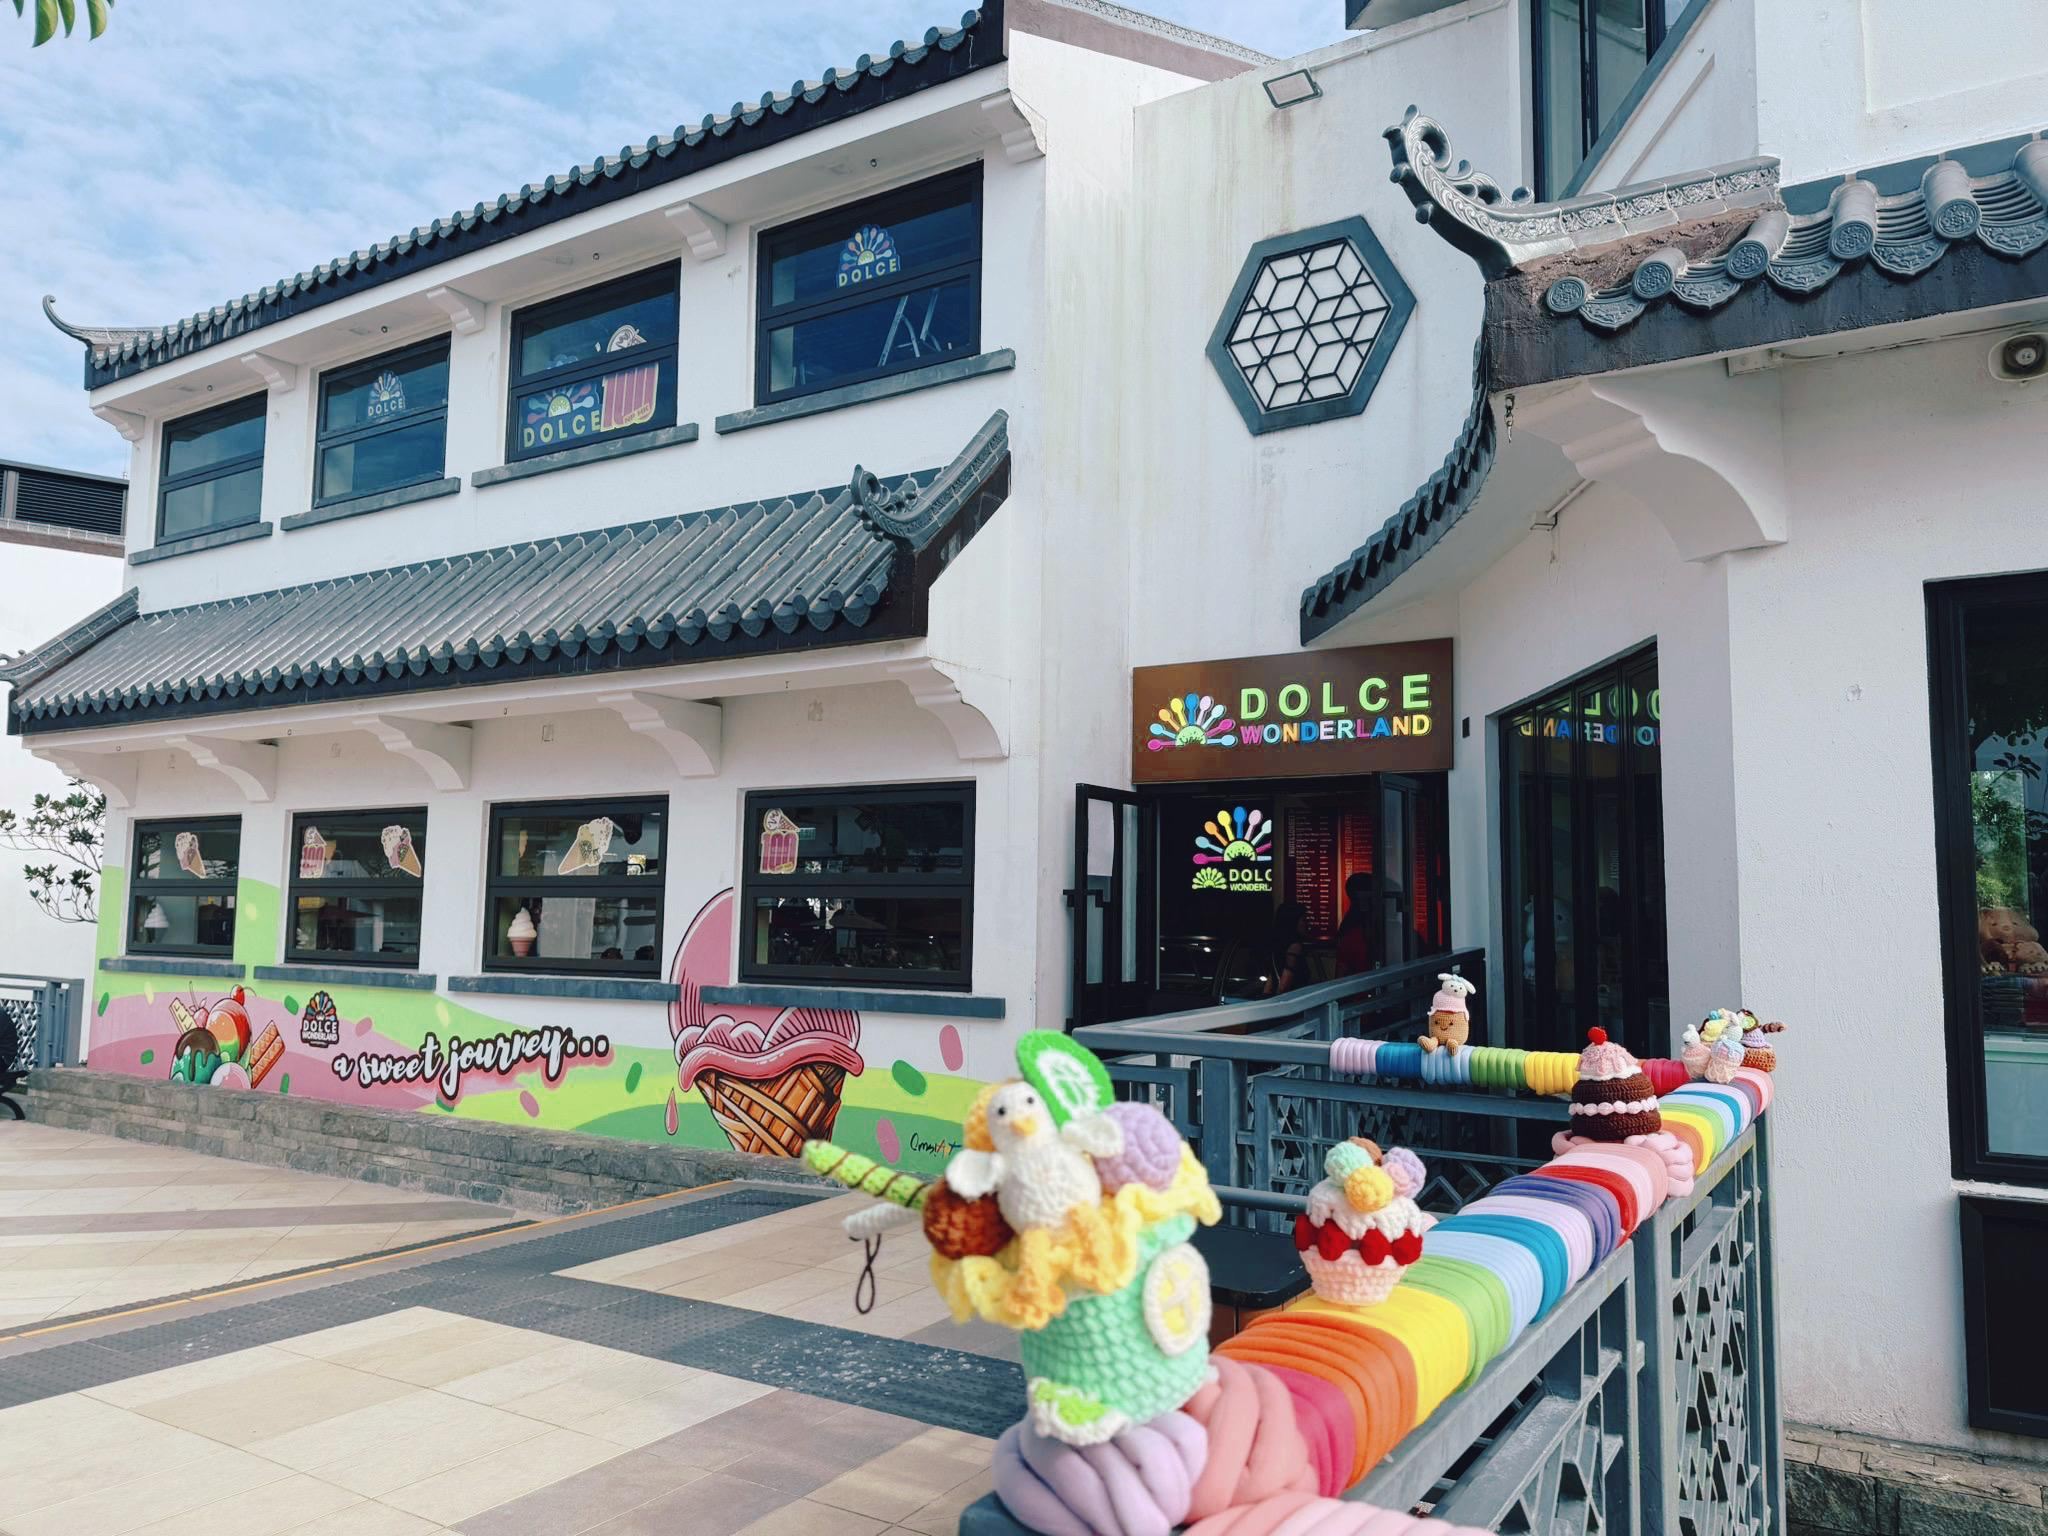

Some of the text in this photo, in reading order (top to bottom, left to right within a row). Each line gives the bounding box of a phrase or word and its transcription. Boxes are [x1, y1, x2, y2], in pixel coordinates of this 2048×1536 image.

[839, 258, 897, 287] DOLCE
[367, 398, 406, 417] DOLCE
[523, 412, 601, 448] DOLCE
[1240, 673, 1432, 721] DOLCE
[1240, 714, 1433, 745] WONDERLAND
[1229, 883, 1273, 892] WONDERL
[302, 1031, 338, 1042] WONDERLAND
[303, 1019, 338, 1034] DOLCE
[333, 1056, 352, 1077] a
[359, 1036, 442, 1084] sweet
